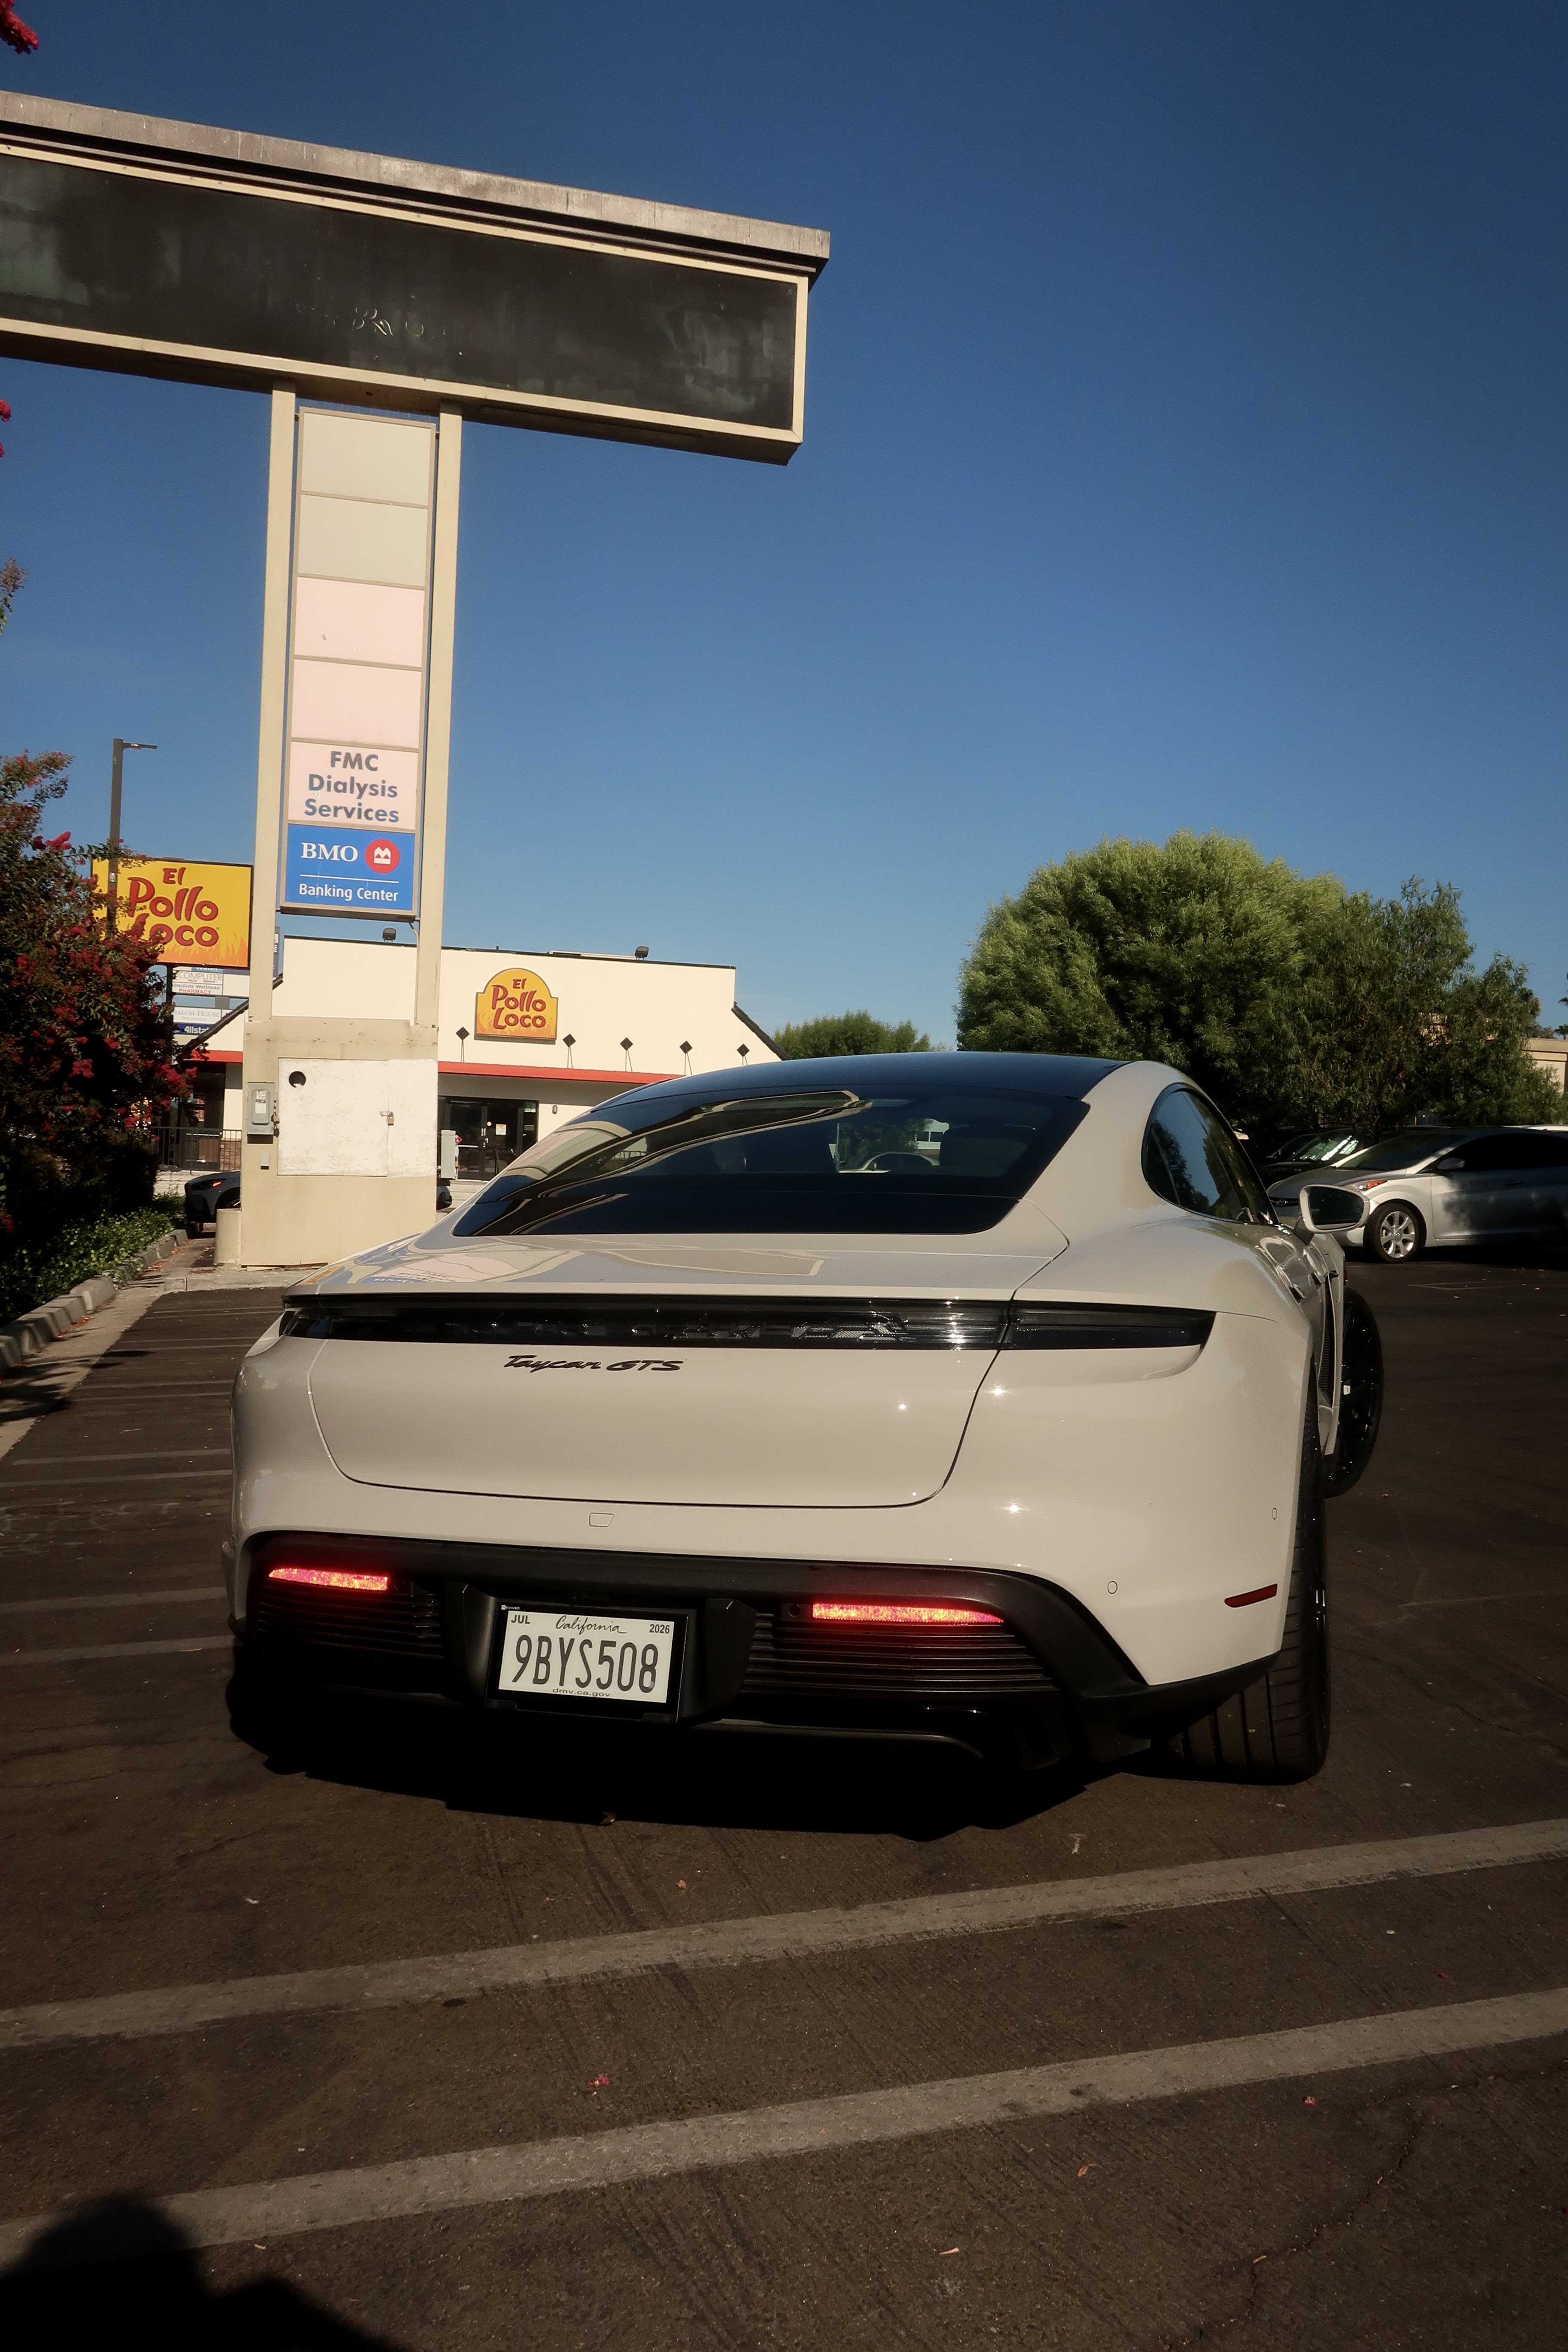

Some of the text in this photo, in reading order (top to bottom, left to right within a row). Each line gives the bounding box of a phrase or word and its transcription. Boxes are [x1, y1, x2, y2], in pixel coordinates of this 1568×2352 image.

[331, 751, 378, 771] FMC
[309, 774, 398, 799] Dialysis
[304, 799, 399, 823] Services
[301, 842, 358, 862] BMO
[163, 867, 186, 885] El
[128, 877, 218, 921] Pollo
[299, 883, 398, 901] Banking Center
[178, 972, 222, 981] COMPUTER
[513, 978, 527, 989] El
[492, 985, 546, 1012] Pollo
[504, 1355, 684, 1373] Taycan GTS
[511, 1614, 670, 1635] JUL California 2026
[512, 1634, 658, 1693] 9BYS508
[552, 1687, 610, 1697] dmv.ca.gov
